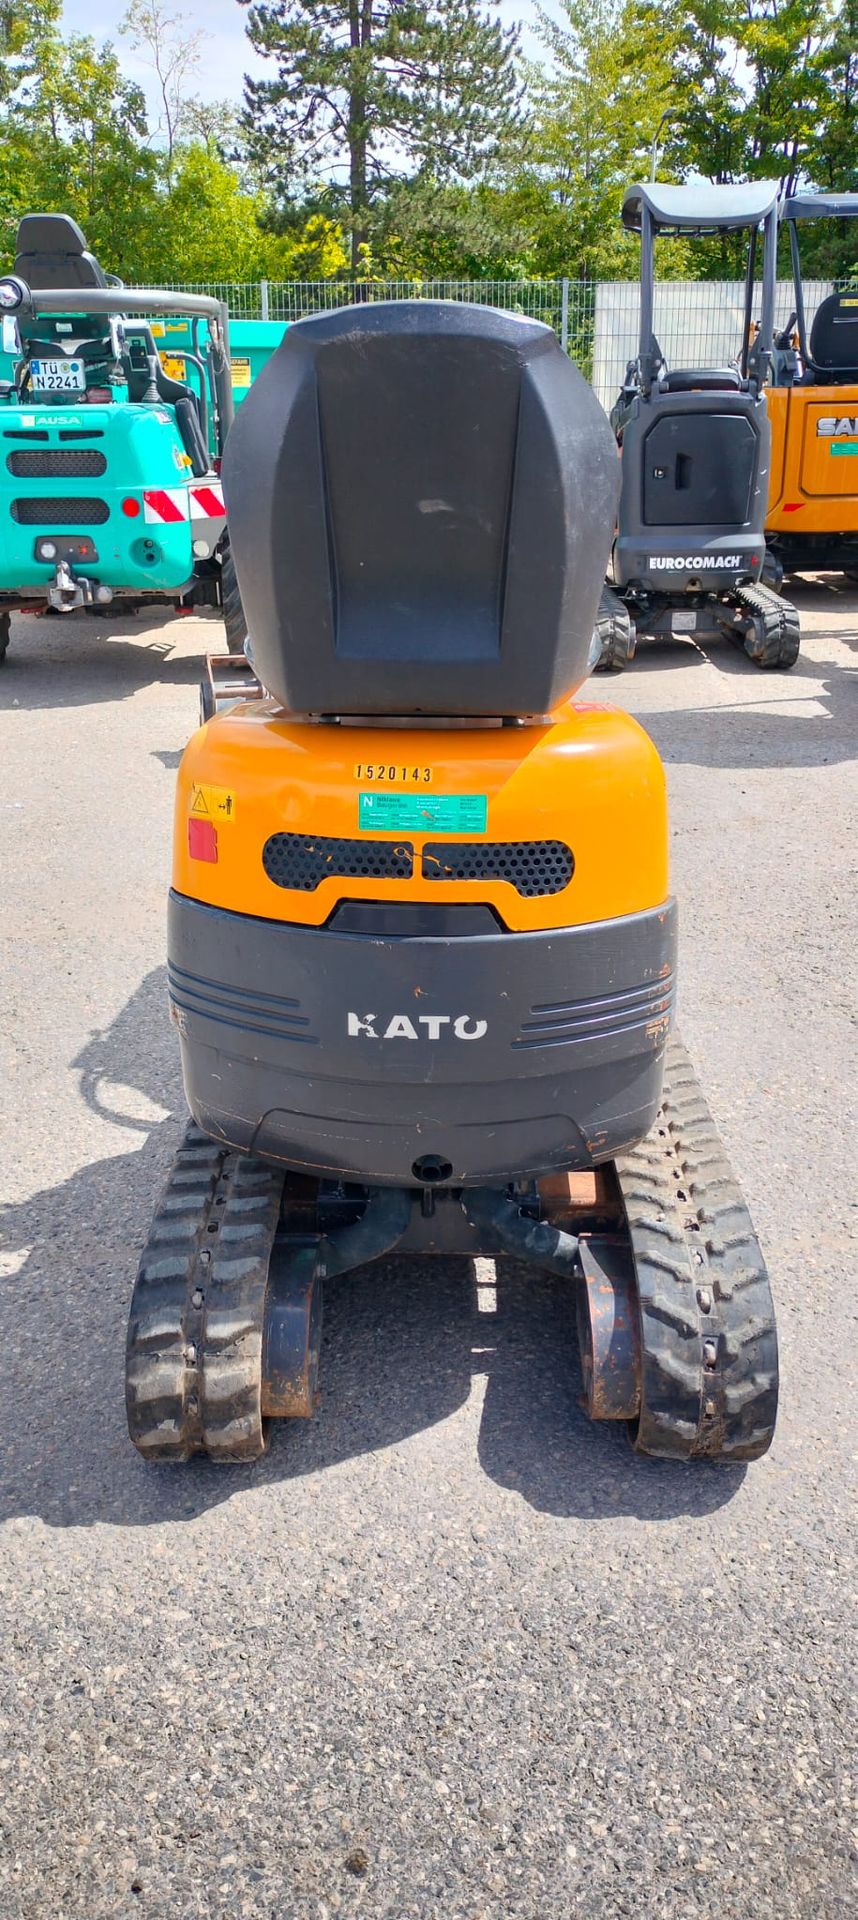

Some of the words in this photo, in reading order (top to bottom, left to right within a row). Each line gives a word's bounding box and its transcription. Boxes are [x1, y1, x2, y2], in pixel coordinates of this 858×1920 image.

[41, 362, 58, 374] TÜ
[37, 376, 45, 388] N
[48, 376, 80, 388] 2241
[36, 416, 80, 425] AUSA
[649, 555, 741, 570] EUROCOMACH
[357, 764, 431, 782] 1520143
[363, 795, 373, 807] N
[347, 1012, 488, 1040] KATO
